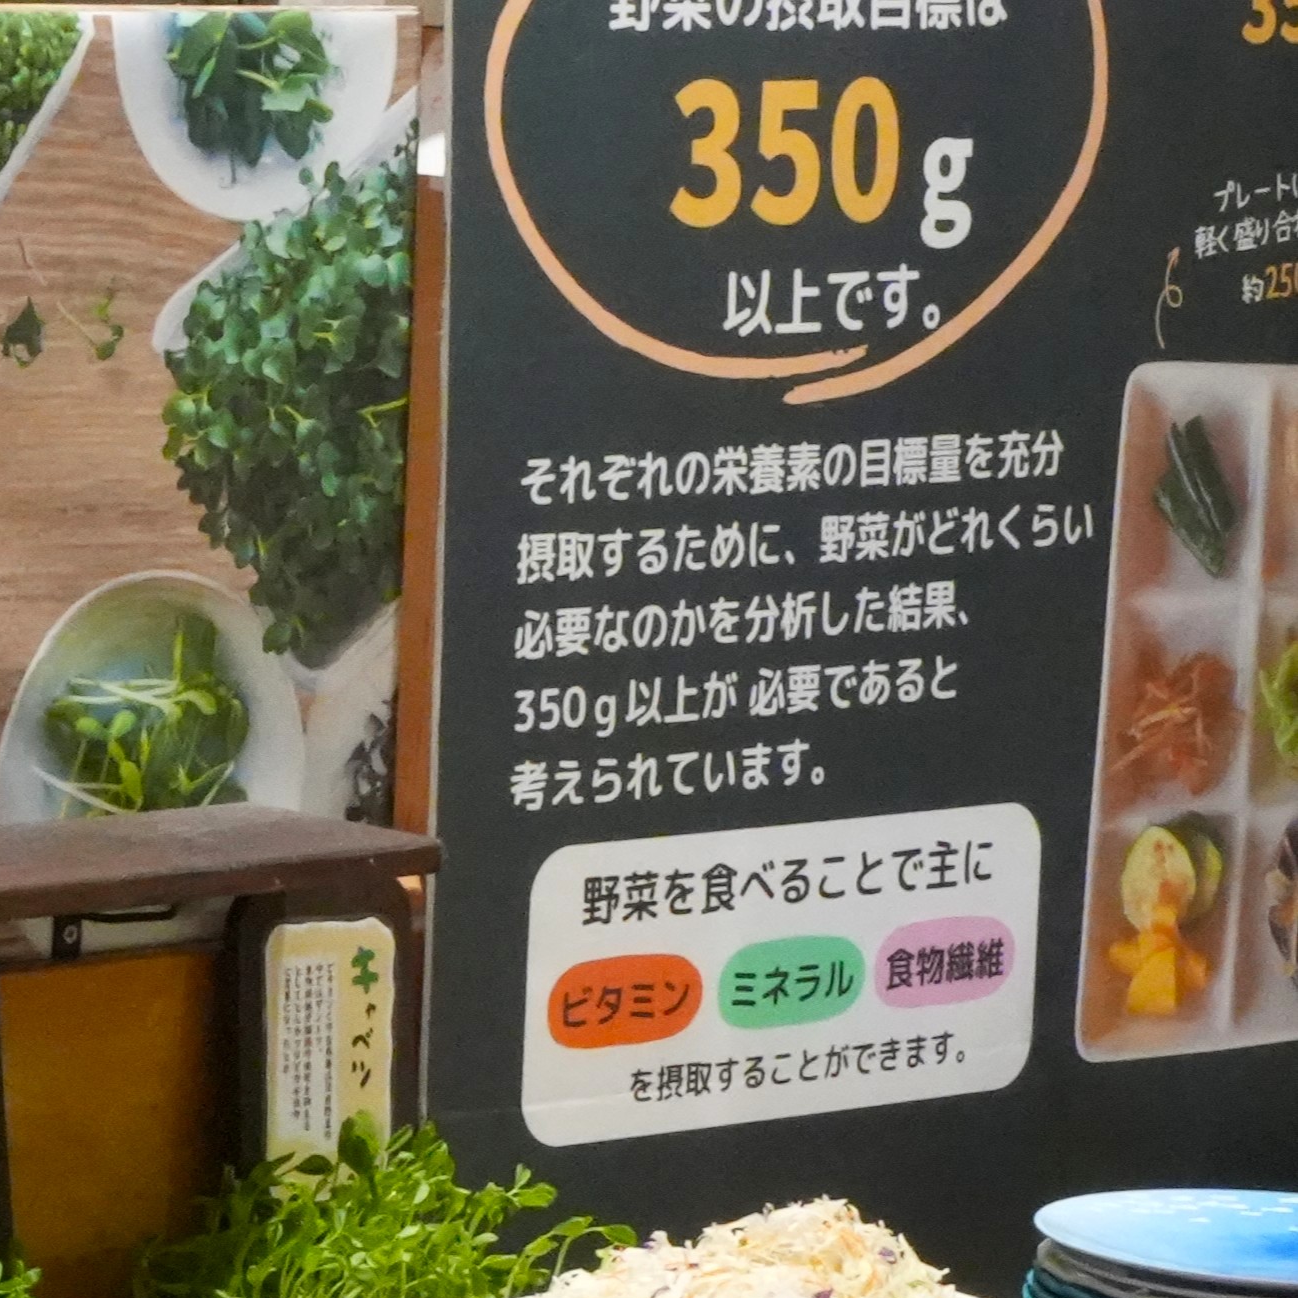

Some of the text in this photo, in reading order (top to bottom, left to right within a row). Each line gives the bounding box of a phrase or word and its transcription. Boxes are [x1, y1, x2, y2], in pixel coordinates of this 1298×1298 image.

[1194, 209, 1298, 259] 軽く盛り合
[721, 263, 940, 337] 以上です。
[520, 430, 1065, 506] それぞれの栄養素の目標量を充分
[515, 503, 1094, 585] 摂取するために、野菜がどれくらい
[513, 581, 970, 661] 必要なのかを分析した結果、
[508, 739, 826, 812] 考えられています。
[581, 840, 994, 927] 野菜を食べることで主に
[730, 957, 853, 1010] ミネラル
[885, 937, 1005, 992] 食物繊維
[560, 977, 693, 1029] ビタミン
[628, 1032, 967, 1104] を摂取することができます。
